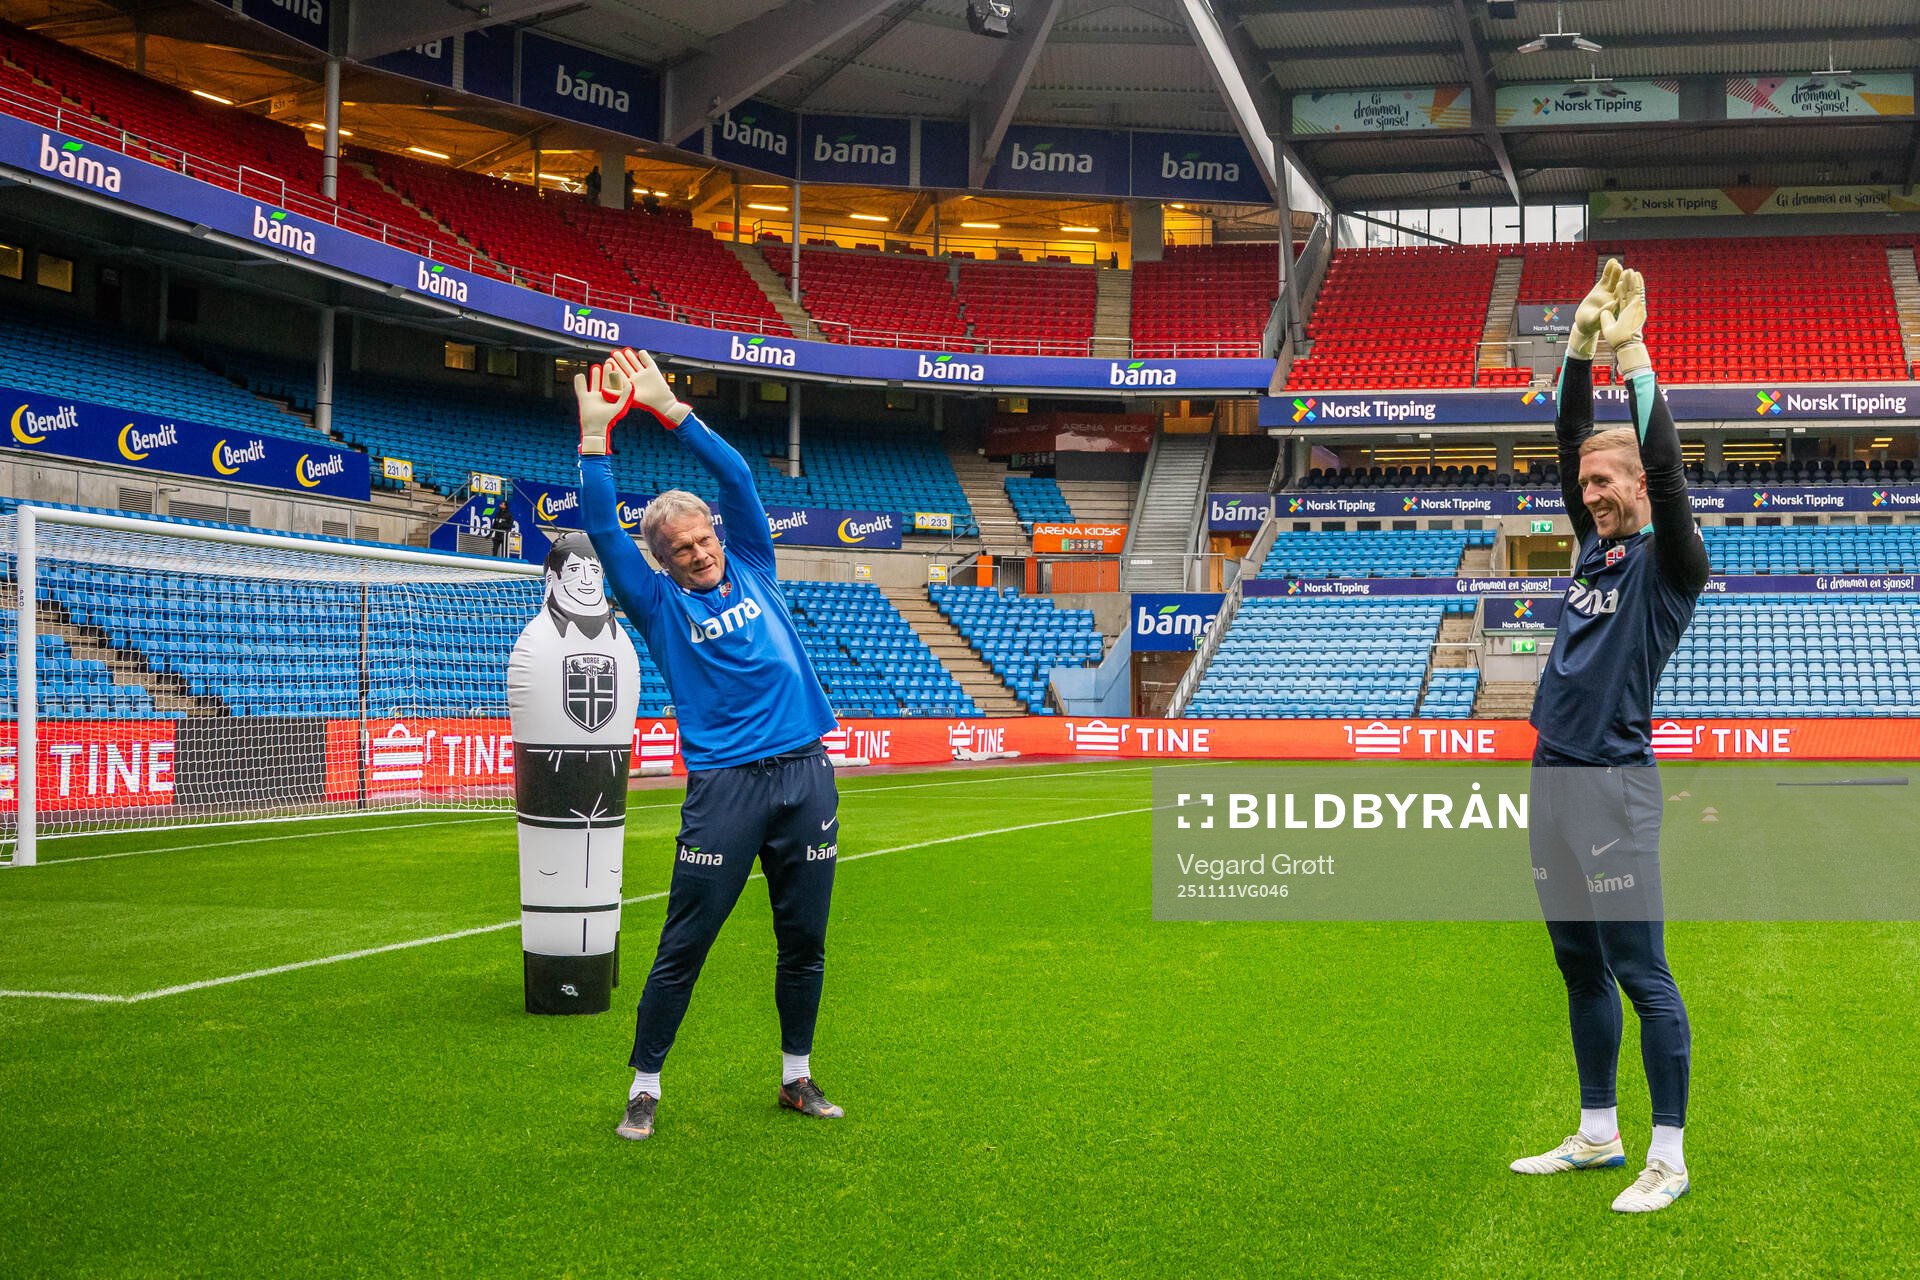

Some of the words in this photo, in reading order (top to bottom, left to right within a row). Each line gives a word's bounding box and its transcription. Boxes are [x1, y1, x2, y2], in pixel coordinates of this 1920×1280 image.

[556, 64, 630, 113] bama
[1371, 93, 1381, 105] Gi
[1353, 100, 1401, 119] drømmen
[1554, 99, 1592, 112] Norsk
[1593, 98, 1642, 113] Tipping
[1801, 102, 1812, 112] en
[1814, 96, 1850, 117] sjanse!
[1363, 117, 1373, 126] en
[1375, 111, 1409, 131] sjanse!
[722, 111, 788, 155] bama
[814, 134, 897, 165] bama
[1011, 143, 1093, 174] bama
[39, 133, 121, 193] bama
[1161, 152, 1240, 182] bama
[1641, 197, 1674, 209] Norsk
[1675, 196, 1718, 211] Tipping
[253, 205, 316, 255] bama
[417, 261, 468, 303] bama
[563, 304, 620, 341] bama
[1550, 324, 1570, 333] Tipping
[730, 335, 796, 367] bama
[918, 354, 985, 382] bama
[1110, 362, 1177, 387] bama
[1321, 401, 1371, 418] Norsk
[1373, 400, 1436, 421] Tipping
[1787, 394, 1839, 411] Norsk
[1840, 393, 1907, 414] Tipping
[26, 405, 79, 435] Bendit
[1062, 423, 1105, 432] ARENA
[1114, 424, 1149, 433] KIOSK
[131, 424, 178, 451] Bendit
[224, 440, 265, 466] Bendit
[306, 454, 344, 479] Bendit
[387, 465, 399, 476] 231
[484, 480, 498, 492] 231
[546, 491, 579, 514] Bendit
[1211, 501, 1270, 521] bama
[1306, 499, 1336, 511] Norsk
[1337, 499, 1375, 512] Tipping
[1421, 498, 1451, 510] Norsk
[1451, 498, 1491, 511] Tipping
[1772, 494, 1803, 505] Norsk
[1804, 494, 1844, 507] Tipping
[469, 506, 520, 538] baa
[769, 510, 808, 534] Bendit
[850, 514, 893, 538] Bendit
[930, 518, 948, 528] 233
[1034, 526, 1082, 536] ARENA
[1084, 527, 1122, 536] KIOSK
[1304, 582, 1333, 593] Norsk
[1333, 582, 1370, 595] Tipping
[1456, 579, 1468, 593] Gi
[1508, 580, 1520, 591] en
[1521, 578, 1552, 592] sjanse!
[1704, 580, 1727, 592] ping
[1816, 577, 1827, 590] Gi
[1829, 576, 1868, 590] drømmen
[1869, 578, 1881, 589] en
[1882, 576, 1915, 591] sjanse!
[1502, 621, 1520, 629] Norsk
[1521, 621, 1545, 630] Tipping
[582, 656, 600, 664] NORGE
[855, 730, 891, 759] TINE
[977, 728, 1005, 753] TINE
[1136, 728, 1210, 753] TINE
[1419, 729, 1495, 753] TINE
[1711, 728, 1791, 753] TINE
[442, 735, 514, 776] TINE
[50, 742, 176, 797] TINE
[680, 845, 723, 866] bama
[1586, 873, 1635, 893] bama
